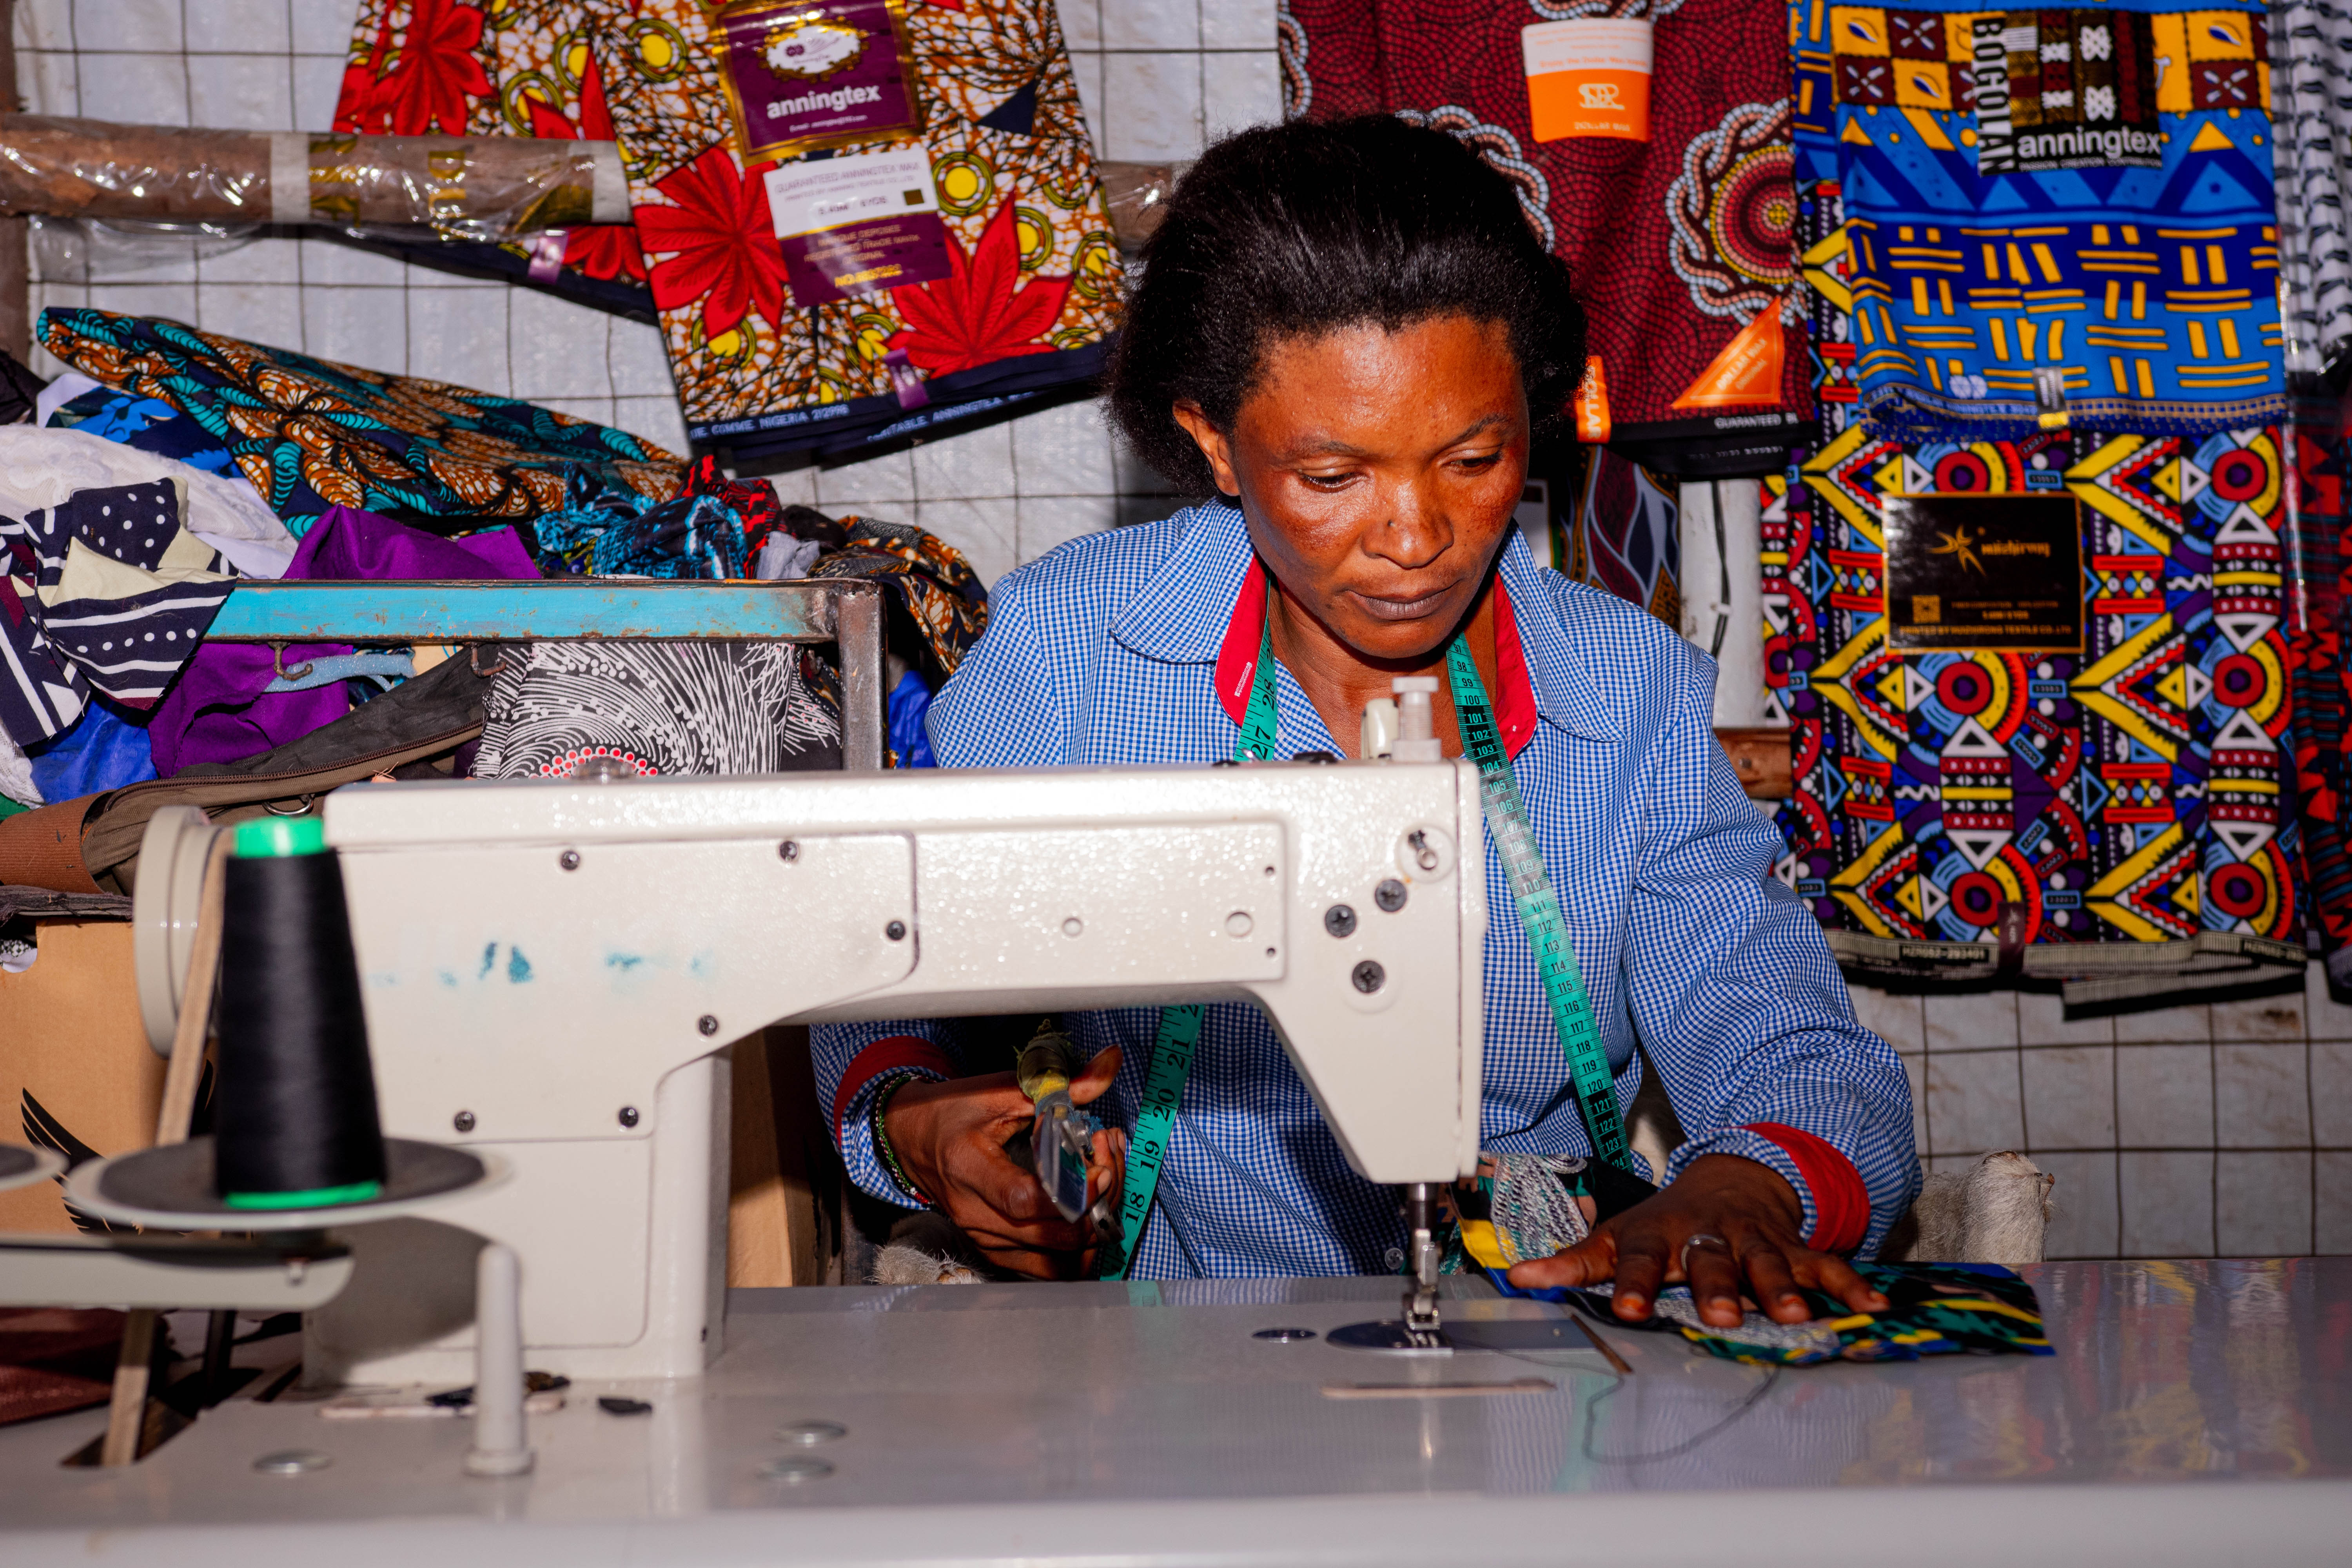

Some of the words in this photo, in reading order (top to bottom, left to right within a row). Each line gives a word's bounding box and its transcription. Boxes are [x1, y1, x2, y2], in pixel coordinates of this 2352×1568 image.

[766, 85, 882, 120] anningtex
[1973, 20, 2015, 177] BOGOLAN
[2017, 125, 2161, 158] anningtex
[775, 172, 838, 194] GUARANTEED
[1716, 354, 1750, 390] DOLLAR
[759, 411, 809, 429] NIGERIA
[1714, 414, 1782, 429] GUARANTEED
[1454, 643, 1462, 653] 97
[1457, 661, 1467, 671] 98
[1462, 678, 1474, 687] 99
[1263, 679, 1275, 712] 28
[1464, 695, 1480, 705] 100
[1468, 713, 1483, 724] 101
[1251, 725, 1271, 760] 27
[1472, 730, 1489, 740] 102
[1476, 745, 1494, 757] 103
[1482, 761, 1500, 775] 104
[1488, 781, 1507, 794] 105
[1495, 799, 1514, 813] 106
[1502, 819, 1519, 835] 107
[1509, 838, 1527, 855] 108
[1515, 859, 1534, 873] 109
[1522, 879, 1541, 894] 110
[1531, 899, 1547, 913] 111
[1537, 919, 1553, 934] 112
[1544, 939, 1560, 953] 113
[1550, 960, 1566, 974] 114
[1557, 980, 1573, 994] 115
[1564, 1000, 1579, 1014] 116
[1570, 1020, 1584, 1034] 117
[1576, 1040, 1591, 1054] 118
[1167, 1039, 1191, 1071] 21
[1582, 1059, 1597, 1073] 119
[1587, 1078, 1603, 1094] 120
[1153, 1088, 1176, 1122] 20
[1594, 1099, 1610, 1114] 121
[1599, 1117, 1615, 1132] 122
[1605, 1137, 1619, 1152] 123
[1140, 1140, 1160, 1174] 19
[1612, 1156, 1624, 1169] 124
[1125, 1192, 1145, 1225] 18
